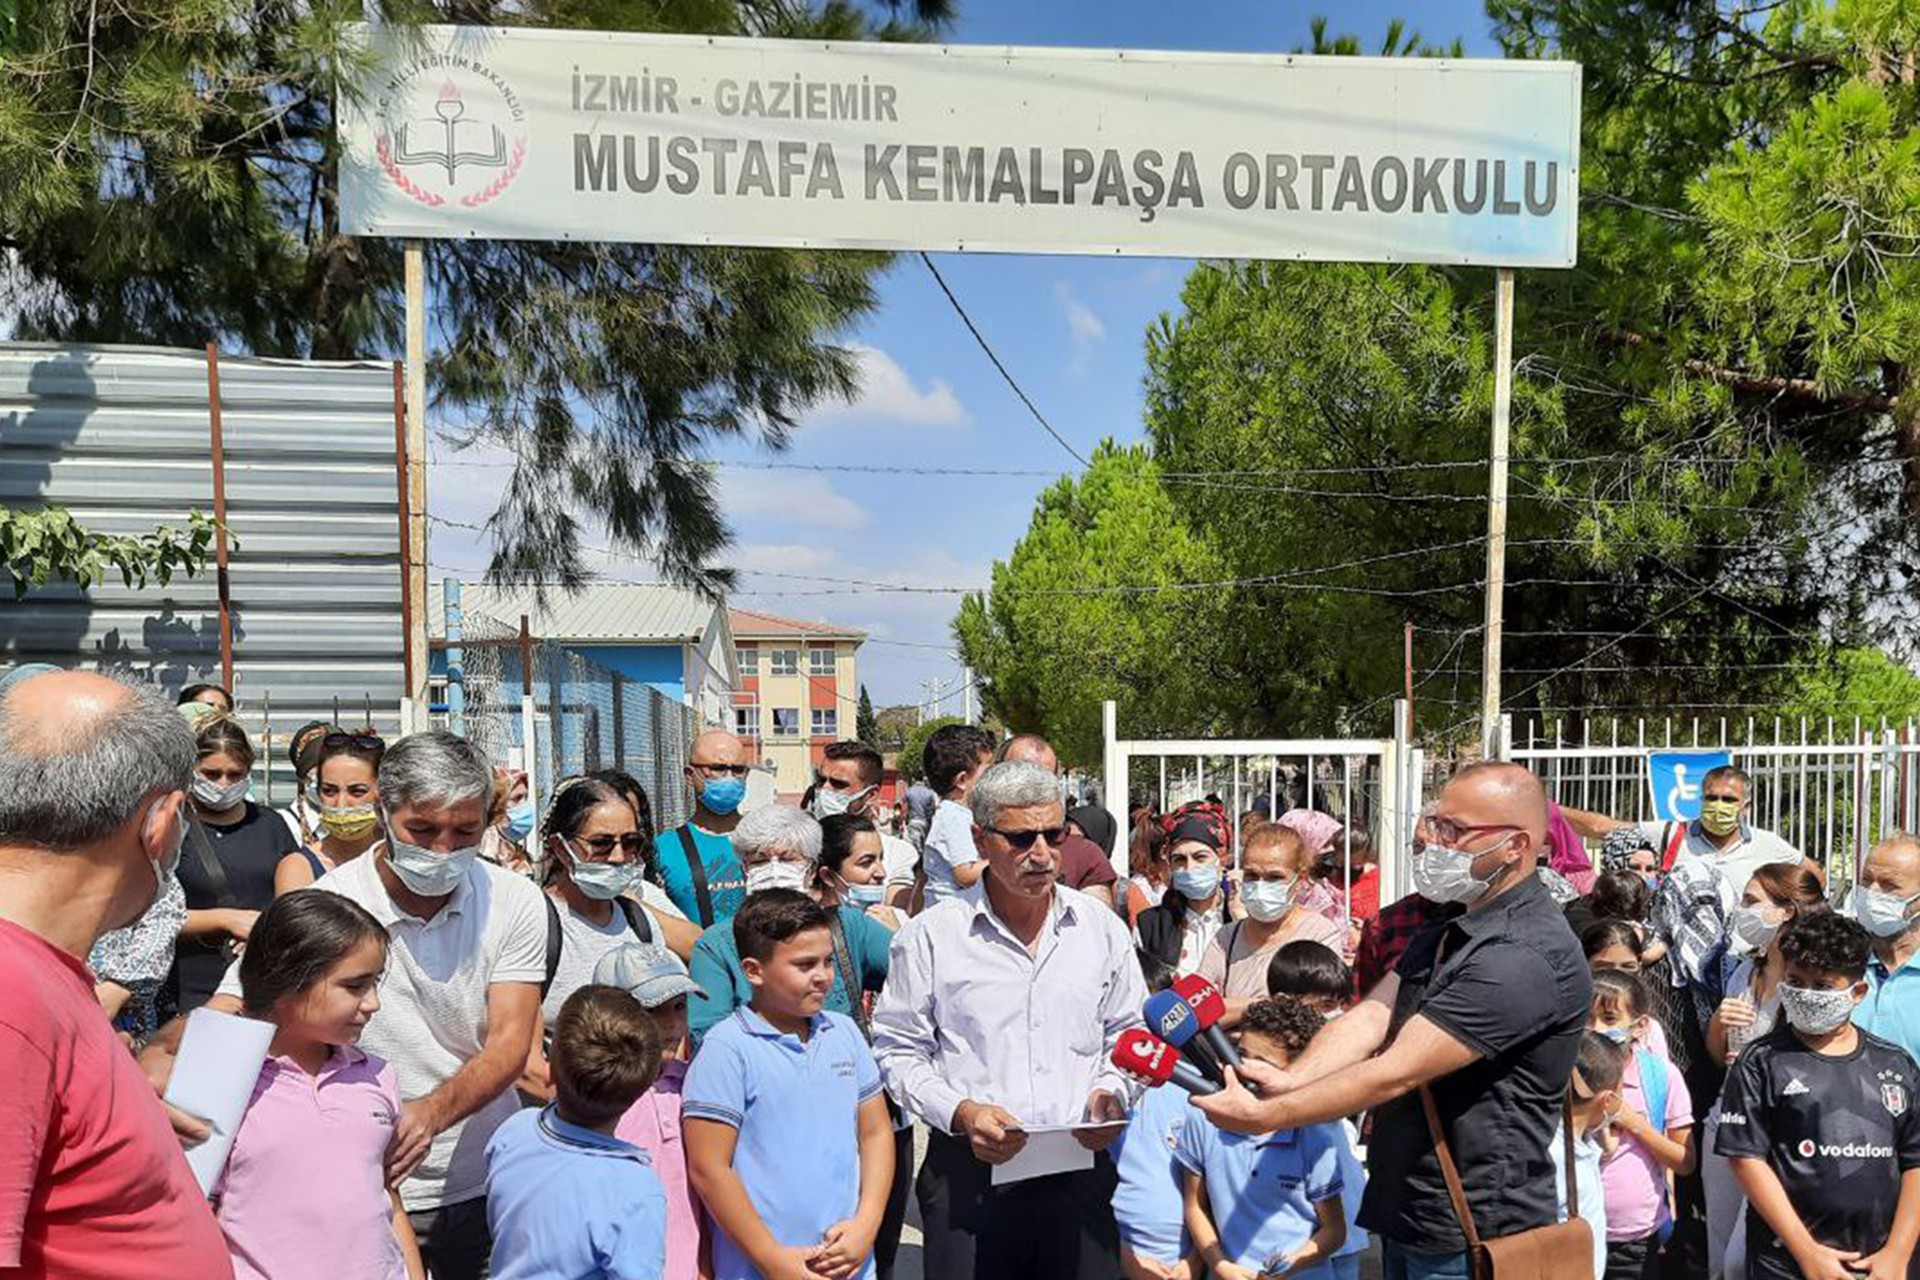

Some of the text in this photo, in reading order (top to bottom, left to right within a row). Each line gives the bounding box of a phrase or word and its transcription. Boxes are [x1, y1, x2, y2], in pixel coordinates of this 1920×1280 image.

[420, 53, 468, 70] EĞİTİM
[471, 62, 525, 122] BAKANLIĞI
[571, 65, 680, 114] İZMİR
[714, 72, 899, 122] GAZİEMİR
[572, 132, 1558, 223] MUSTAFA KEMALPAŞA ORTAOKULU
